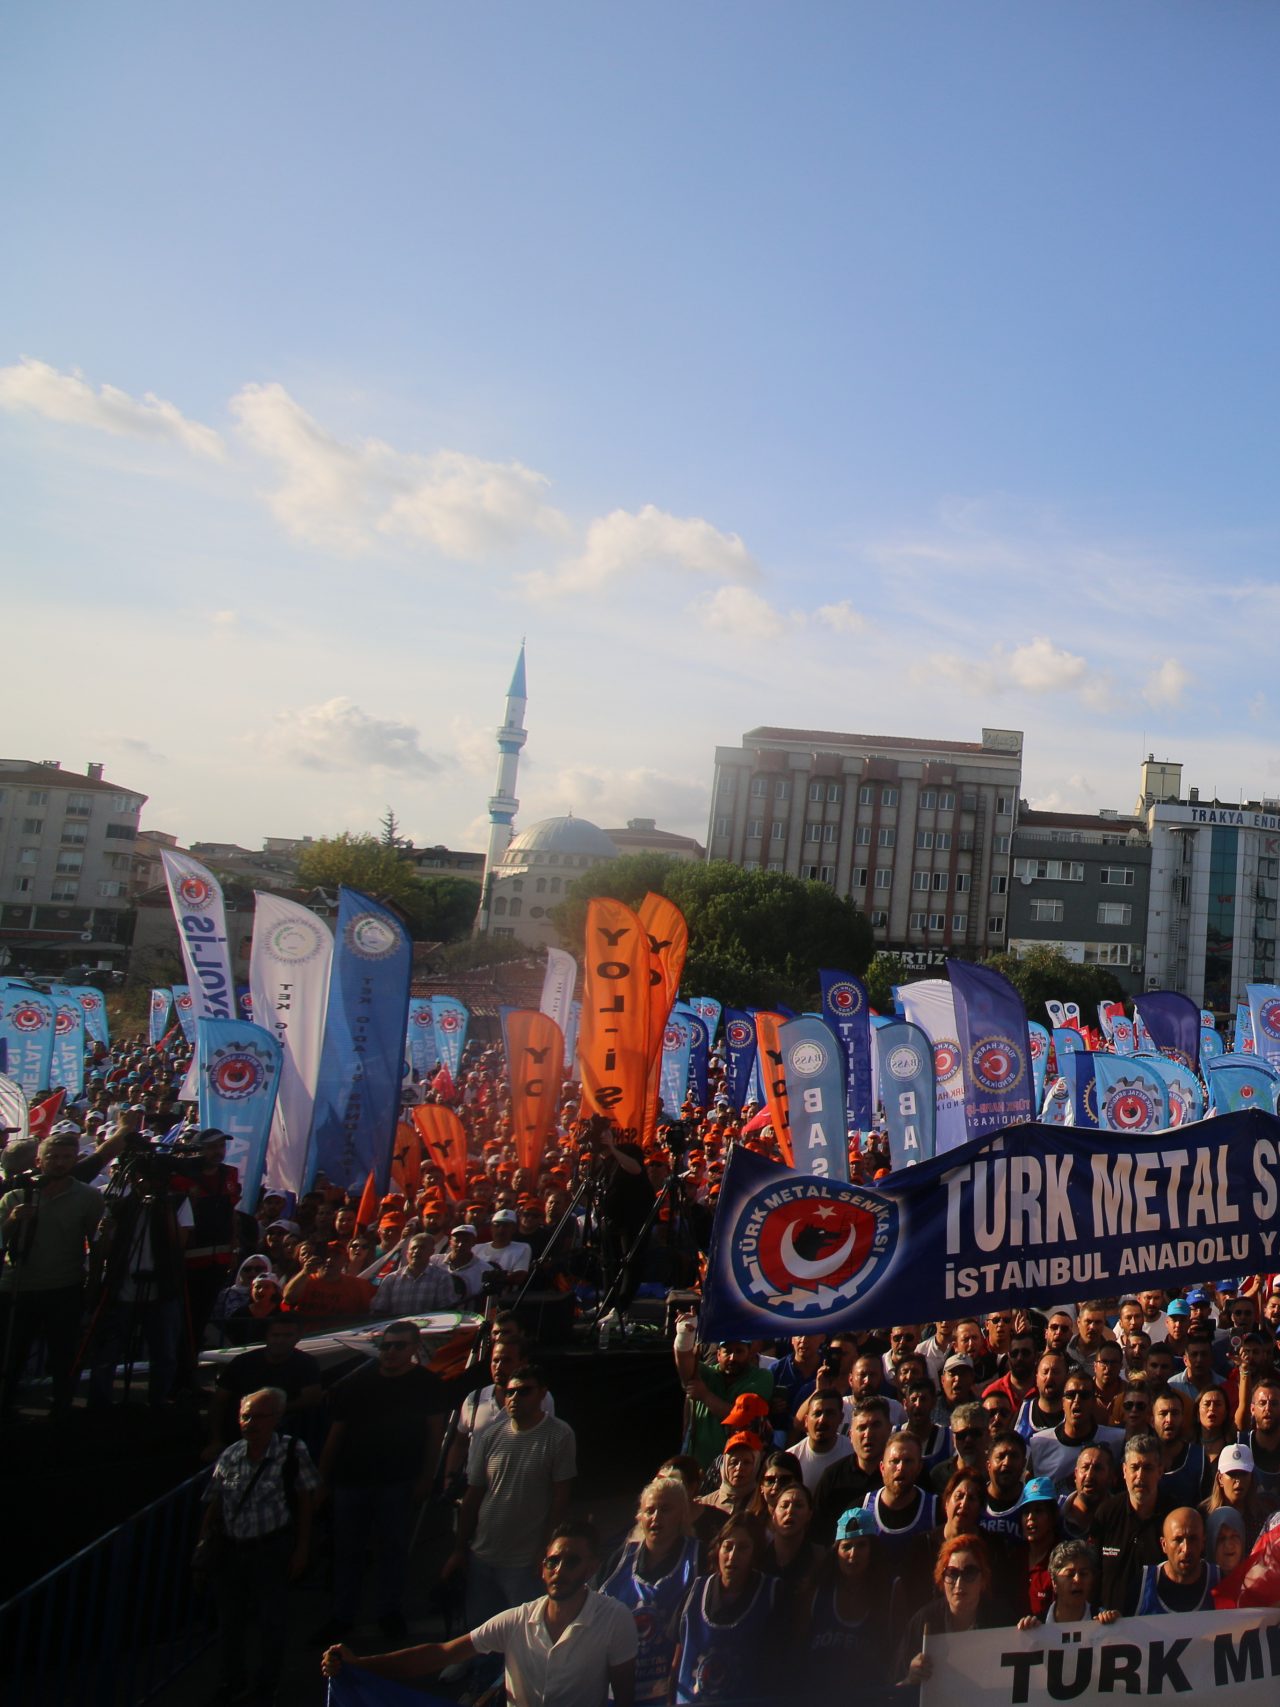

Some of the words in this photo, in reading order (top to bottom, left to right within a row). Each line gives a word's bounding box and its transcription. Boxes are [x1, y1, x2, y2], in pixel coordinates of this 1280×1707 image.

[1192, 809, 1244, 825] TRAKYA
[743, 1206, 768, 1267] TÜRK
[764, 1184, 832, 1211] METAL
[838, 1191, 891, 1254] SENİKASI
[939, 1135, 1078, 1255] TÜRK
[1090, 1144, 1239, 1238] METAL
[945, 1251, 1110, 1300] İSTANBUL
[1118, 1233, 1250, 1276] ANADOLU
[1001, 1630, 1194, 1704] TÜRK
